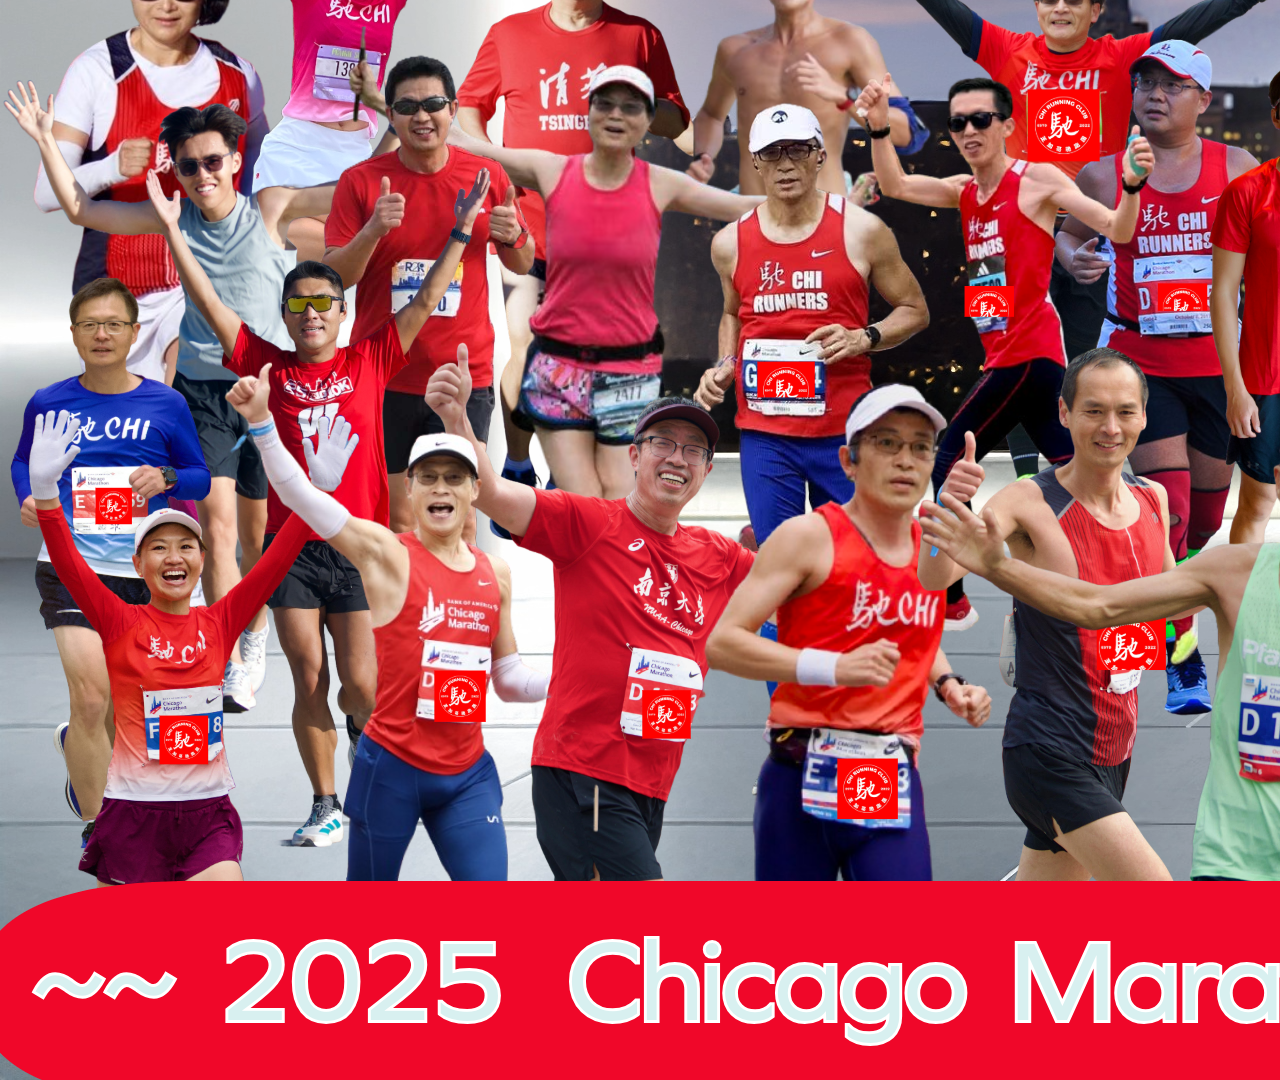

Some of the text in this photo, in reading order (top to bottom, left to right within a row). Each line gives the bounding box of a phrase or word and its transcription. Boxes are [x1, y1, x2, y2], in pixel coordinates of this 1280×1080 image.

[360, 4, 390, 23] CHI
[1058, 69, 1100, 90] CHI
[1177, 211, 1208, 231] CHI
[1137, 231, 1213, 254] RUNNERS
[791, 270, 823, 290] CHI
[753, 292, 829, 314] RUNNERS
[1138, 287, 1151, 310] D
[105, 417, 150, 440] CHI
[447, 606, 485, 621] Chicago
[898, 591, 939, 628] CHI
[448, 618, 490, 633] Marathon
[651, 663, 671, 672] Chicago
[1241, 708, 1260, 736] D
